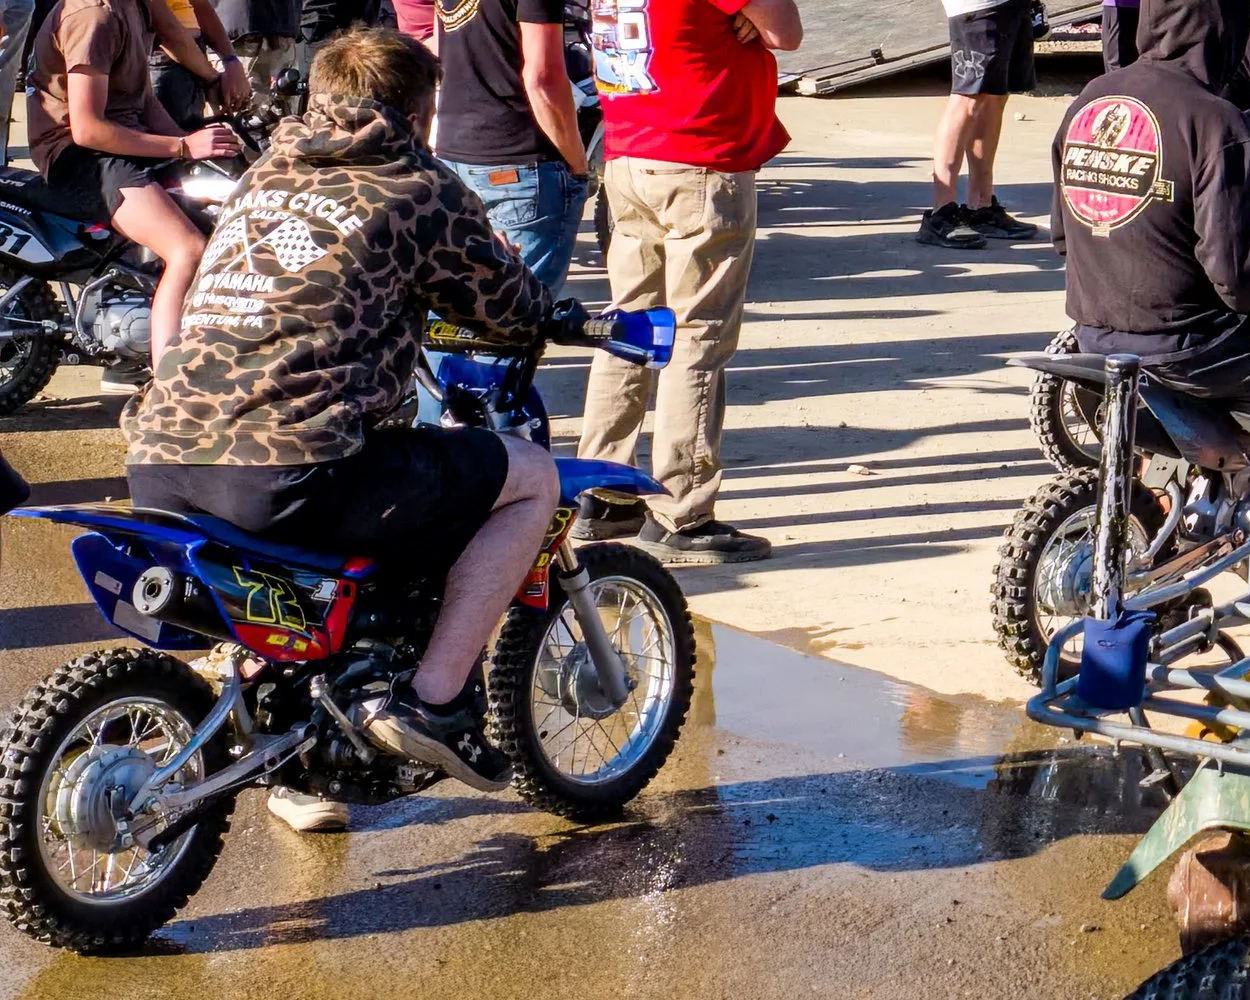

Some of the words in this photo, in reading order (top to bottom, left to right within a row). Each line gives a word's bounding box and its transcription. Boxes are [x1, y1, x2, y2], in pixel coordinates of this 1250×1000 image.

[1064, 146, 1154, 176] PENSKE
[1066, 168, 1098, 184] RACING
[1098, 171, 1139, 190] SHOCKS
[288, 191, 364, 238] CYCLE
[213, 273, 273, 293] YAMAHA
